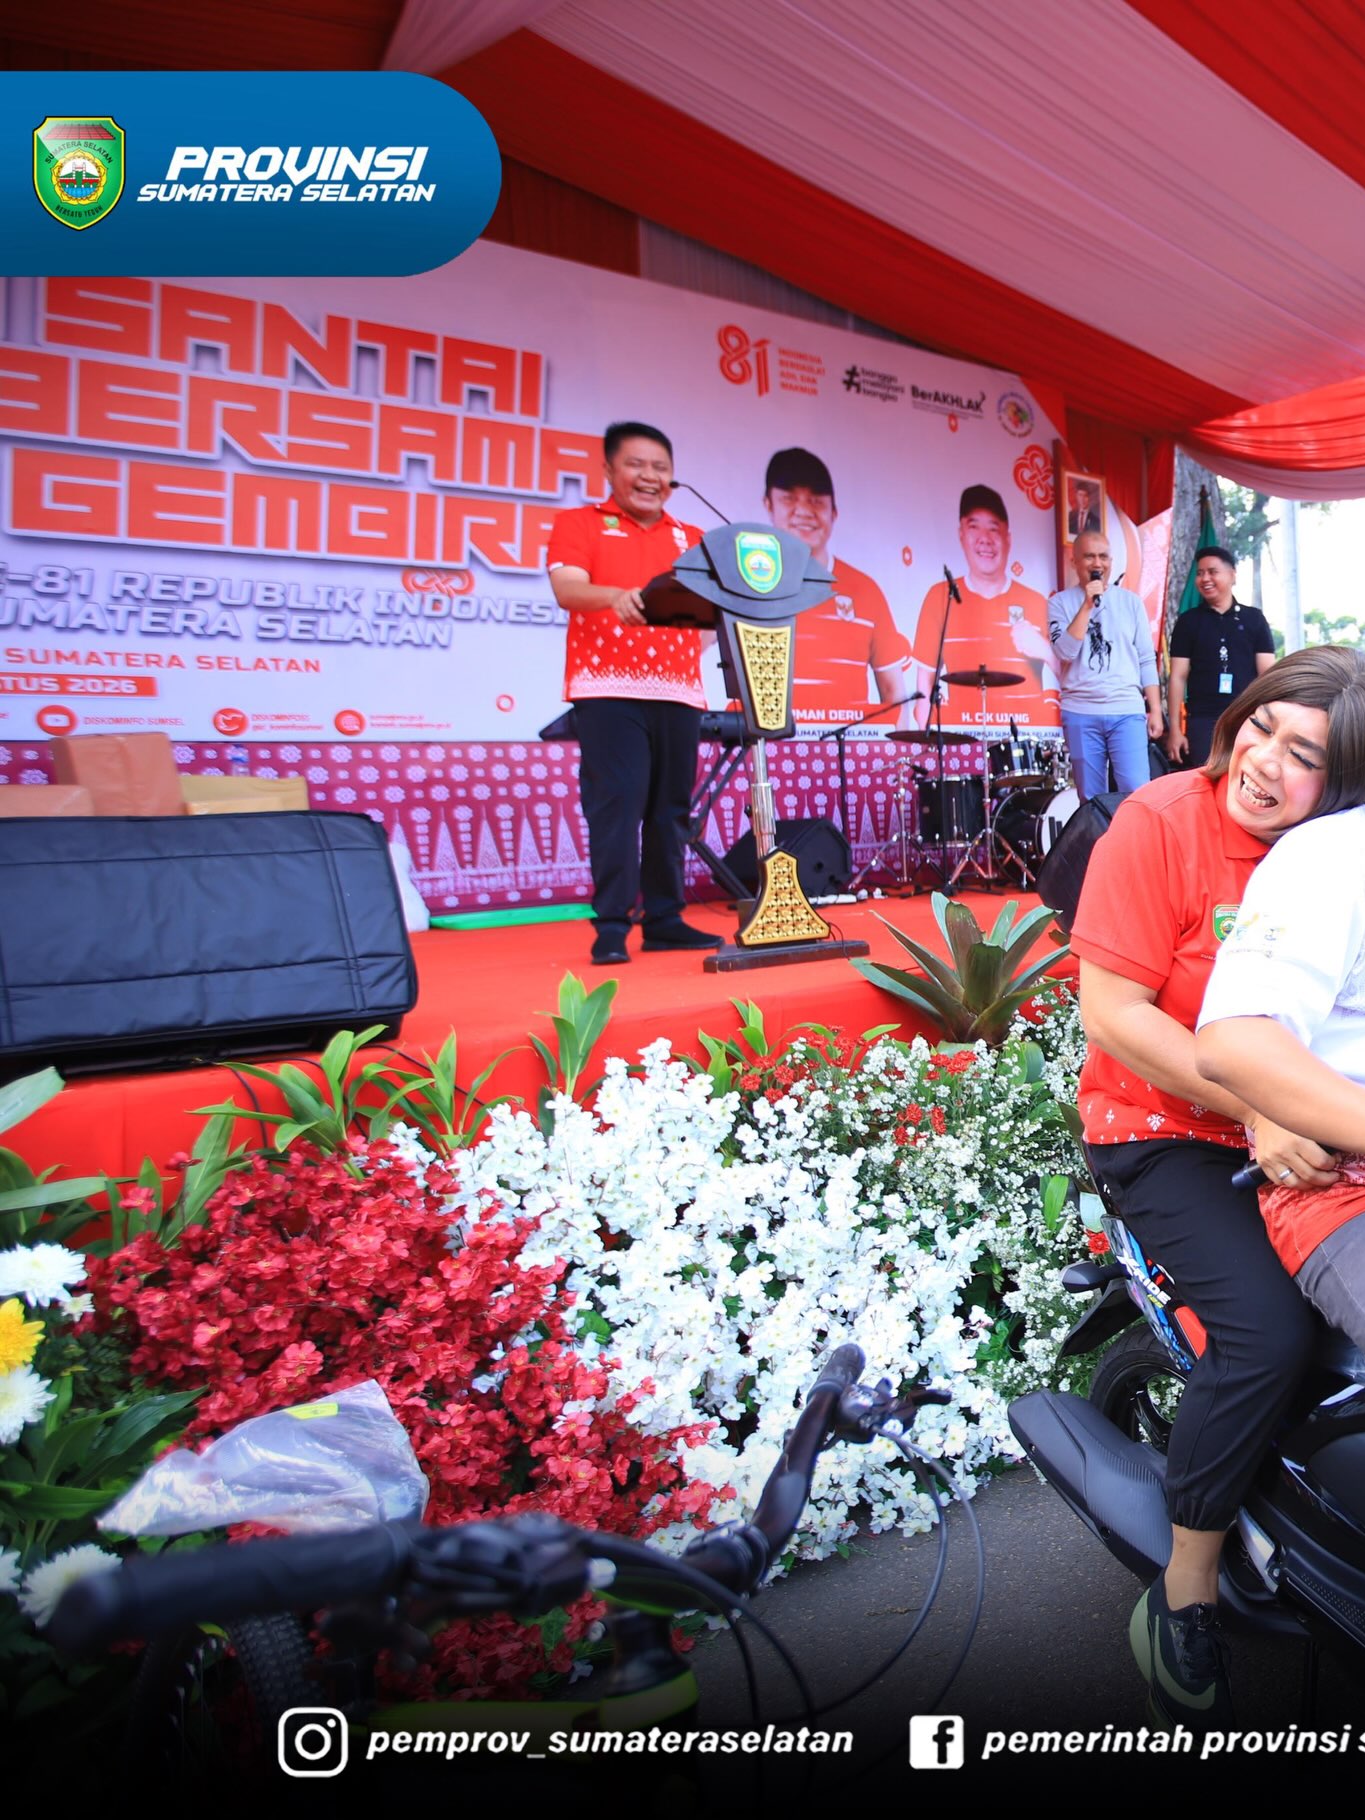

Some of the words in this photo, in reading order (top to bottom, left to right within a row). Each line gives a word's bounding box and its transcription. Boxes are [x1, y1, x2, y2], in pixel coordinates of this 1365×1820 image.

[45, 277, 544, 418] SANTAI
[717, 323, 770, 397] 81
[911, 384, 985, 412] BerAKHLAK
[112, 570, 363, 613] REPUBLIK
[256, 612, 452, 648] SELATAN
[5, 647, 186, 670] SUMATERA
[196, 655, 321, 673] SELATAN
[66, 677, 138, 694] 2026
[828, 709, 864, 721] DERU
